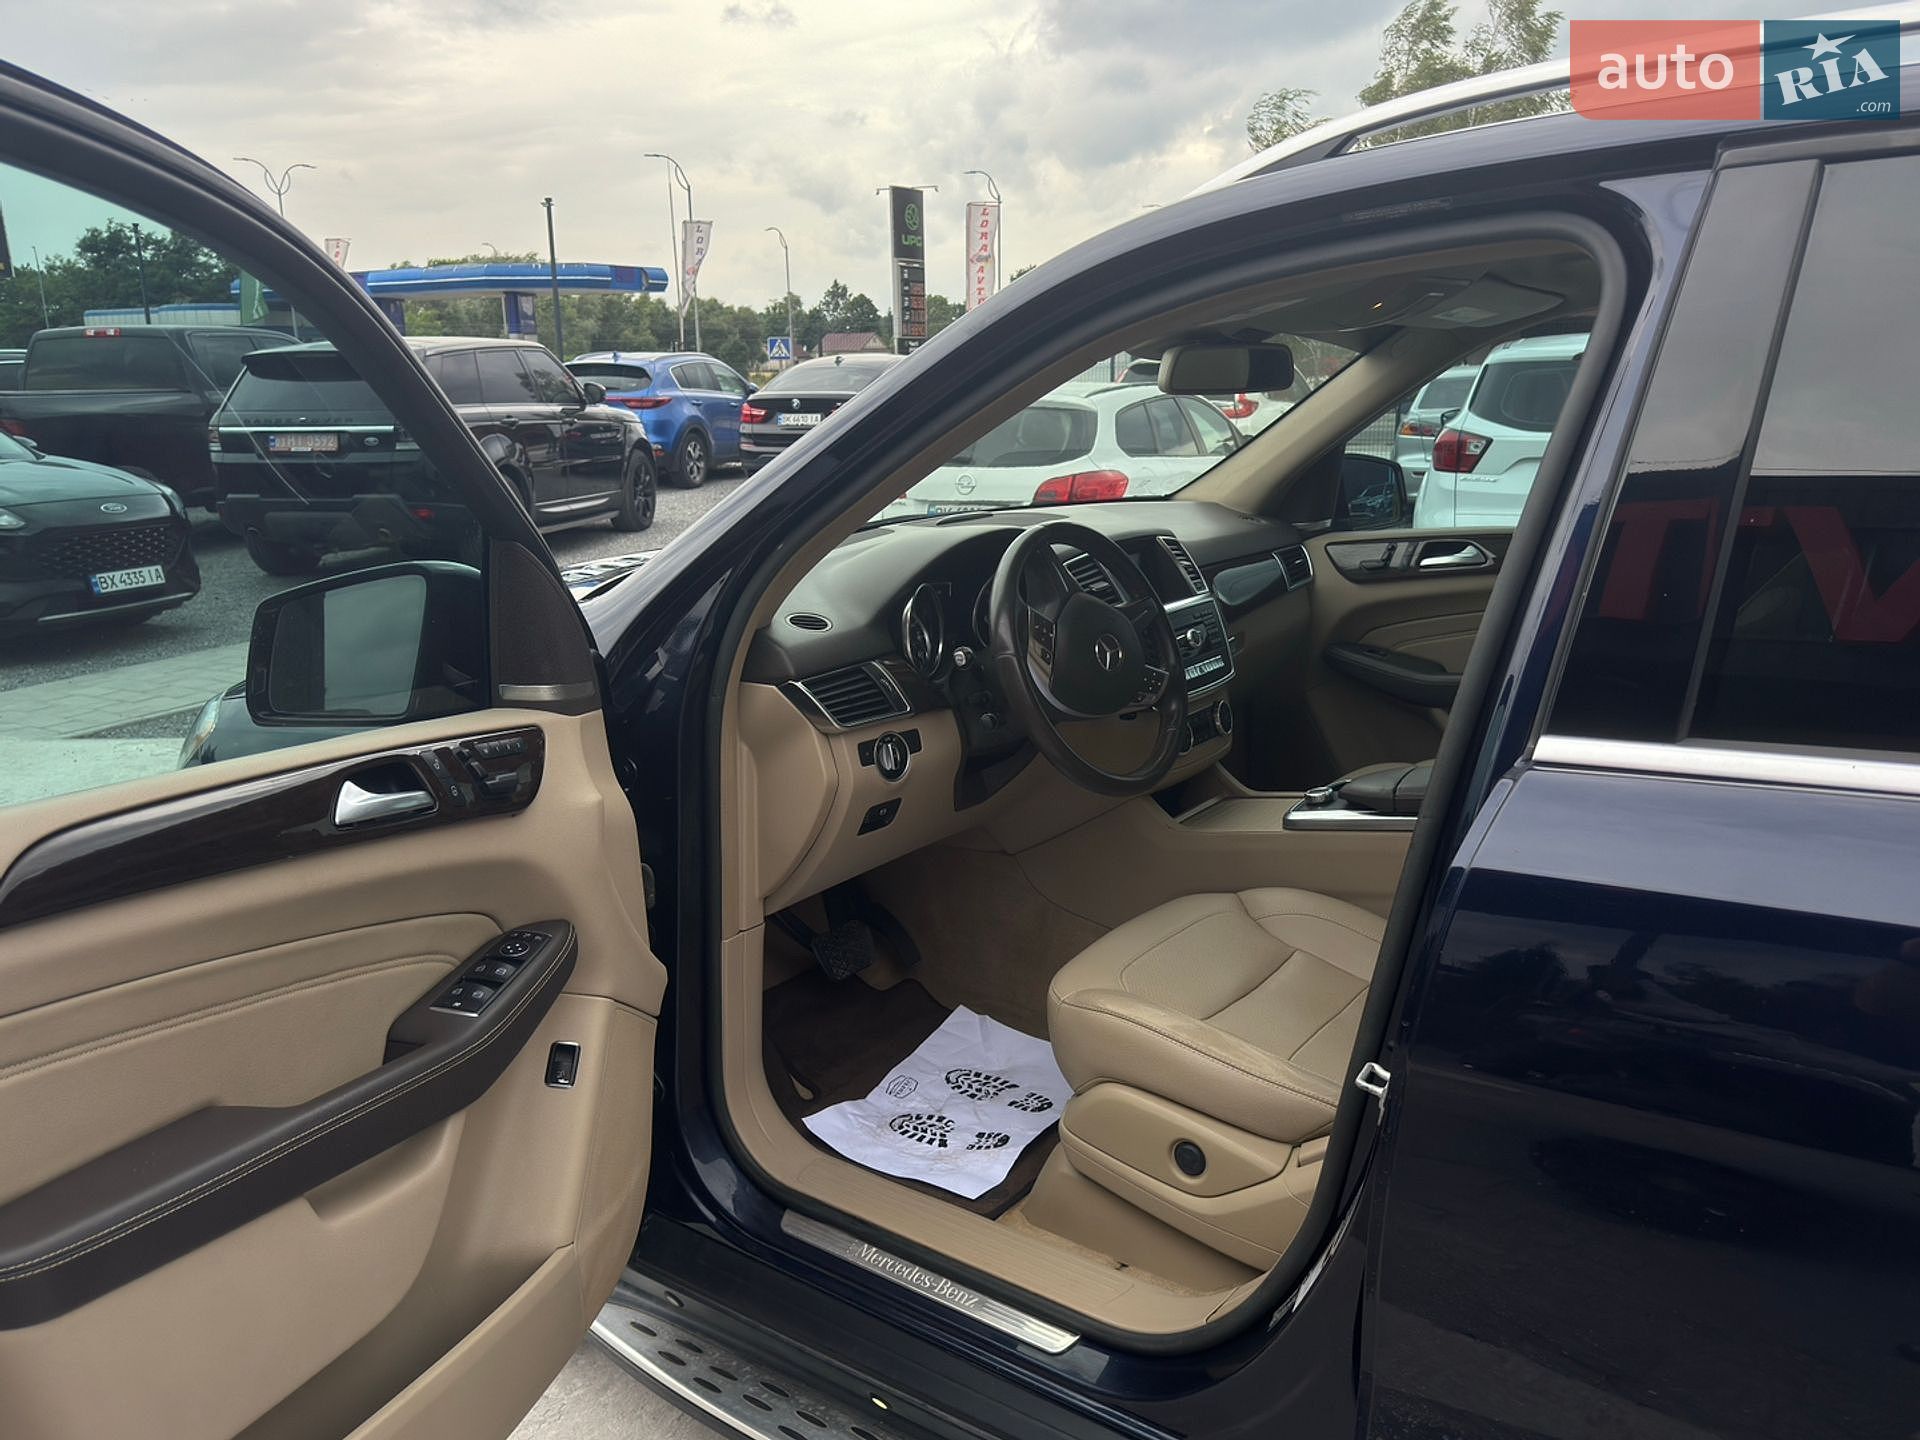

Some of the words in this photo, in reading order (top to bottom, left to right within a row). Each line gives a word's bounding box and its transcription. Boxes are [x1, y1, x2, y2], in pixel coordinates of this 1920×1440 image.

[98, 574, 118, 590] BX
[119, 570, 146, 587] 4335
[857, 1243, 977, 1308] Mercedes-Benz
